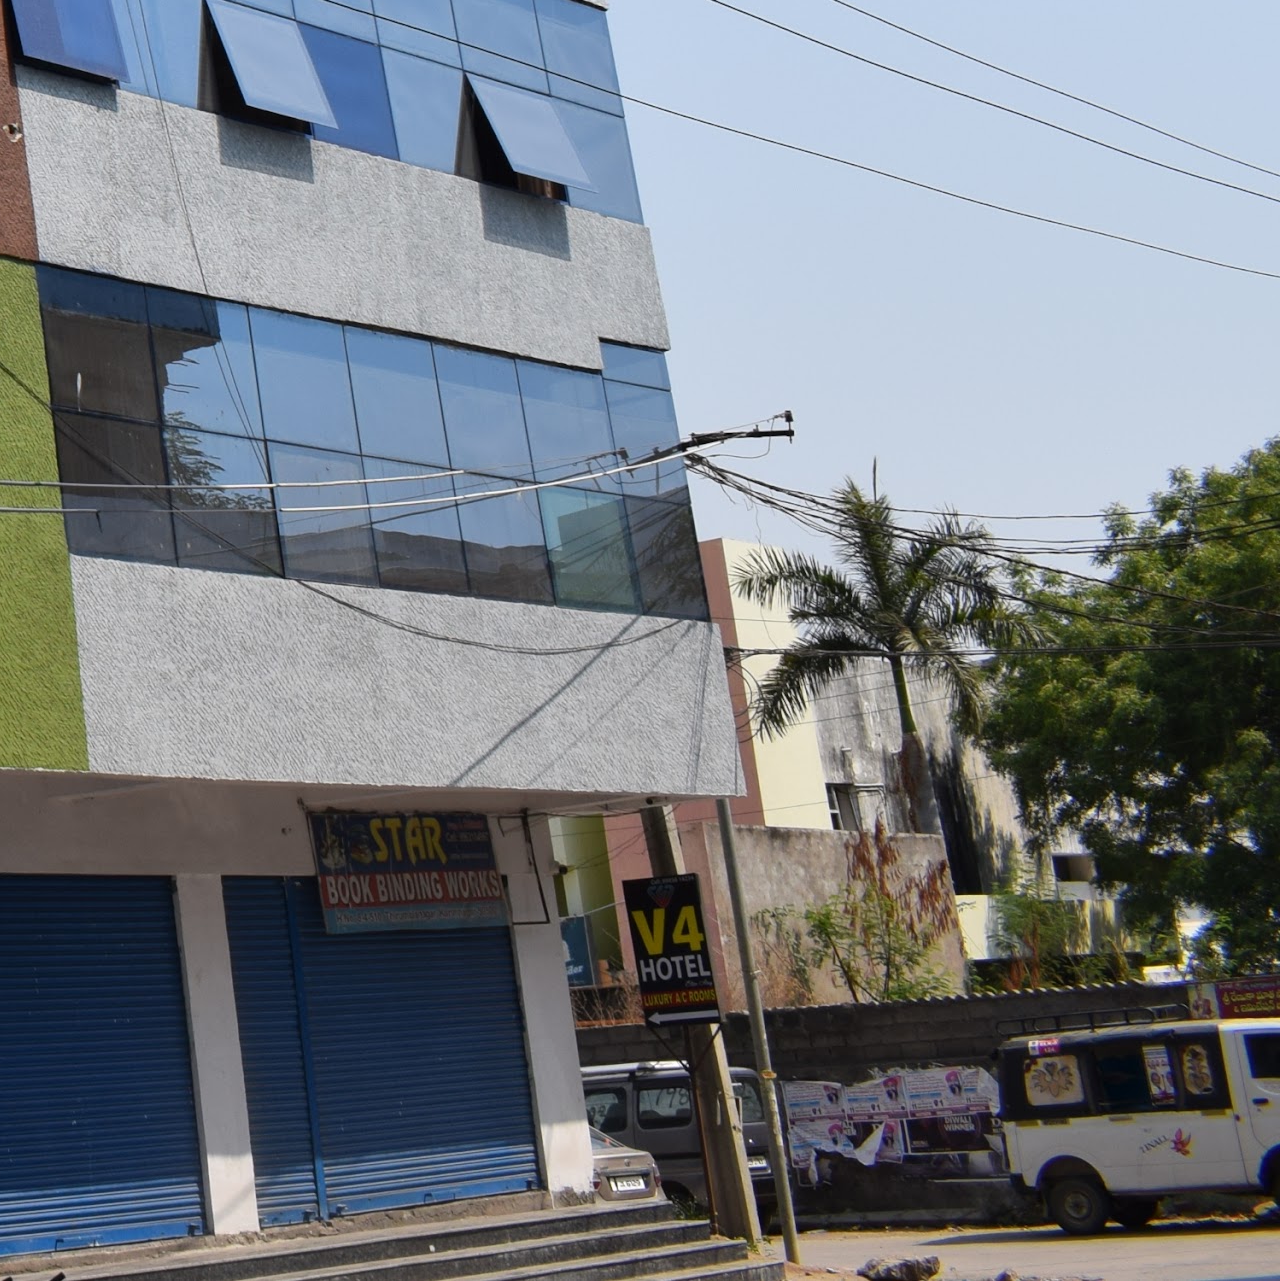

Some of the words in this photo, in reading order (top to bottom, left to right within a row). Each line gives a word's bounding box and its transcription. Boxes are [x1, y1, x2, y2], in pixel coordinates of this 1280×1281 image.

[369, 817, 447, 866] STAR
[326, 875, 375, 905] BOOK
[376, 871, 443, 902] BINDING
[444, 868, 500, 899] WORKS
[631, 905, 704, 955] V4
[640, 953, 711, 982] HOTEL
[643, 993, 673, 1007] LUXURY
[688, 989, 716, 1003] ROOMS
